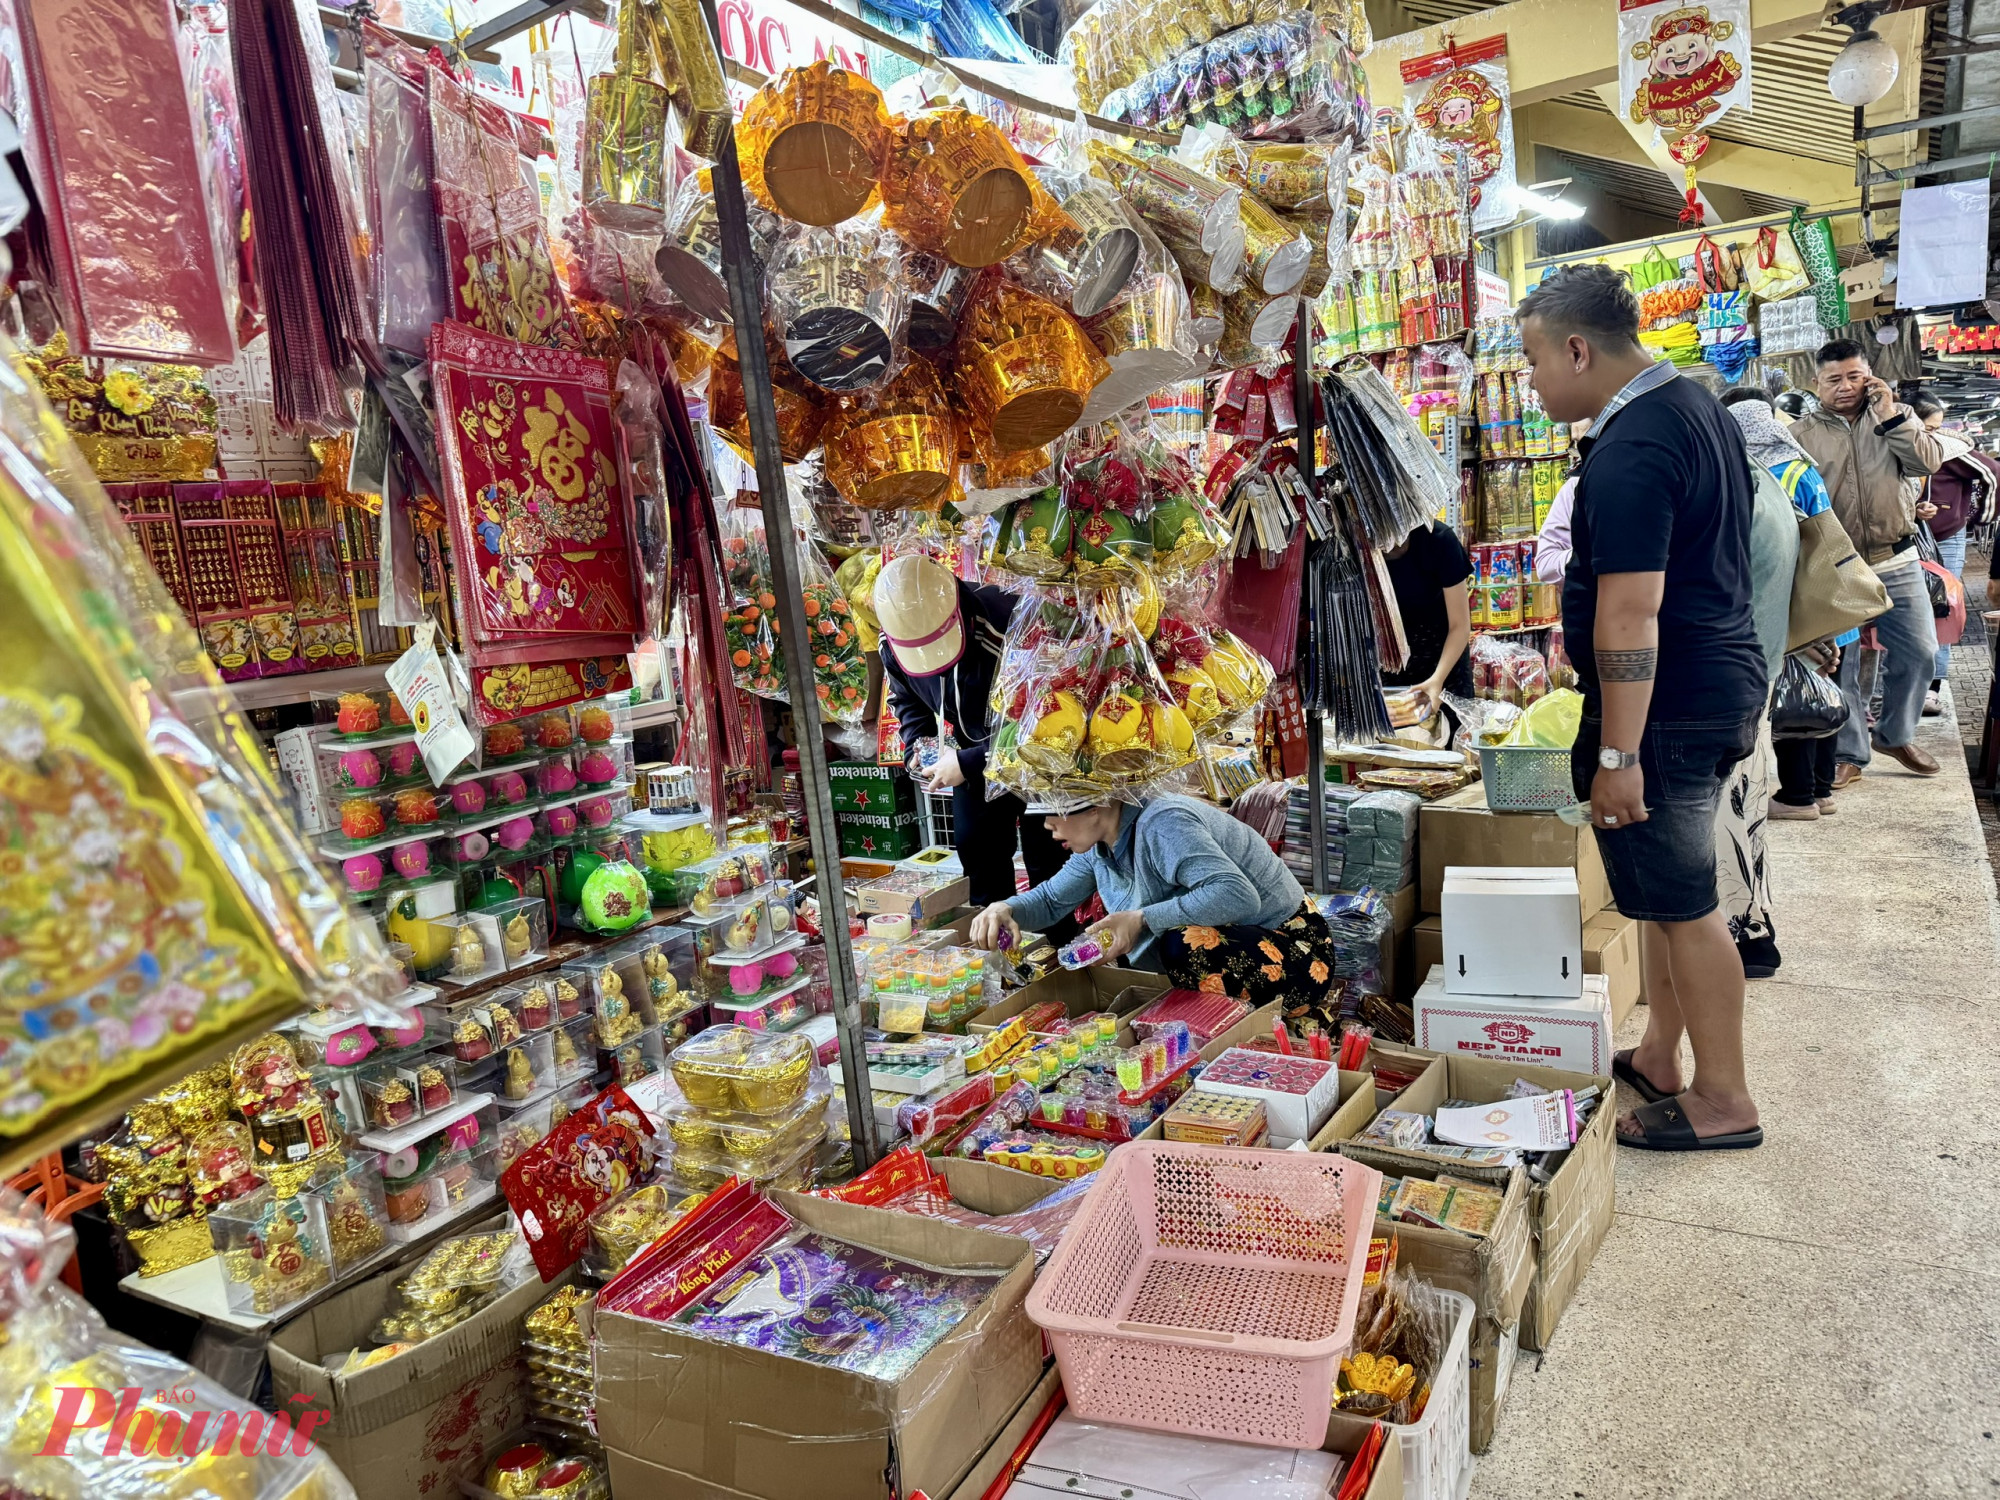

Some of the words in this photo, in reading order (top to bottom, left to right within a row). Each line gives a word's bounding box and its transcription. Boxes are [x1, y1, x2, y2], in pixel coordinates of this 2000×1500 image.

[829, 766, 890, 780] Heineken
[839, 812, 891, 829] Heineken
[678, 1269, 711, 1297] Hồng
